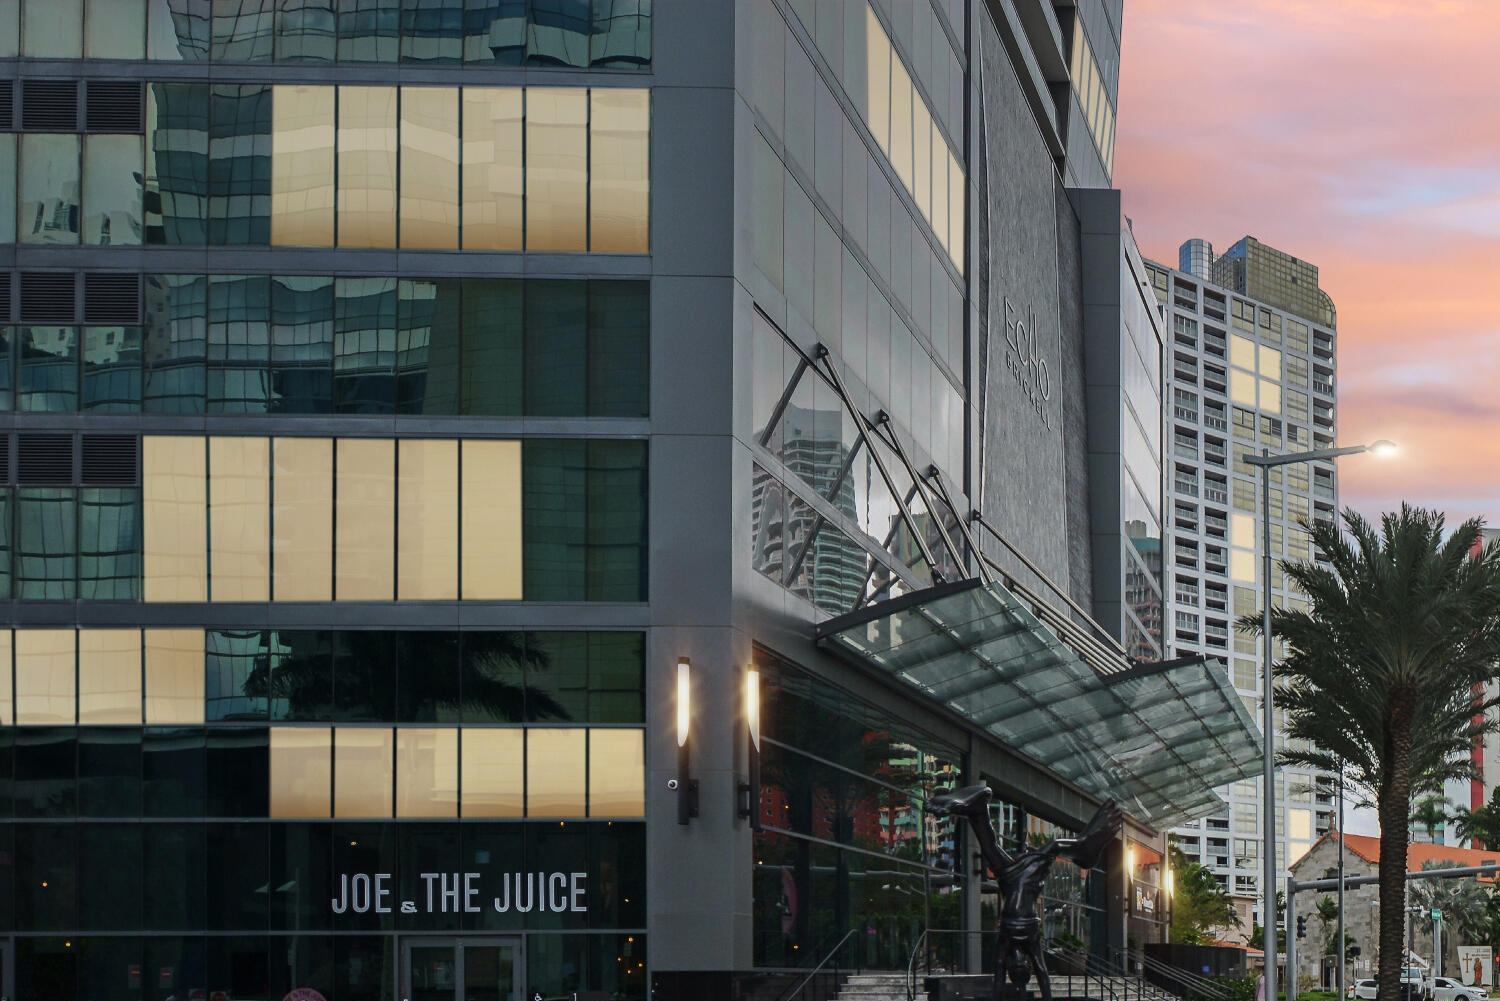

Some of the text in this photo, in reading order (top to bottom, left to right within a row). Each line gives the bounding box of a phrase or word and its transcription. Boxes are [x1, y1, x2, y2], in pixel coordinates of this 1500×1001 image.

[1004, 296, 1050, 401] ECHO
[1006, 351, 1051, 432] BRICKELL
[331, 871, 587, 914] JOE & THE JUICE
